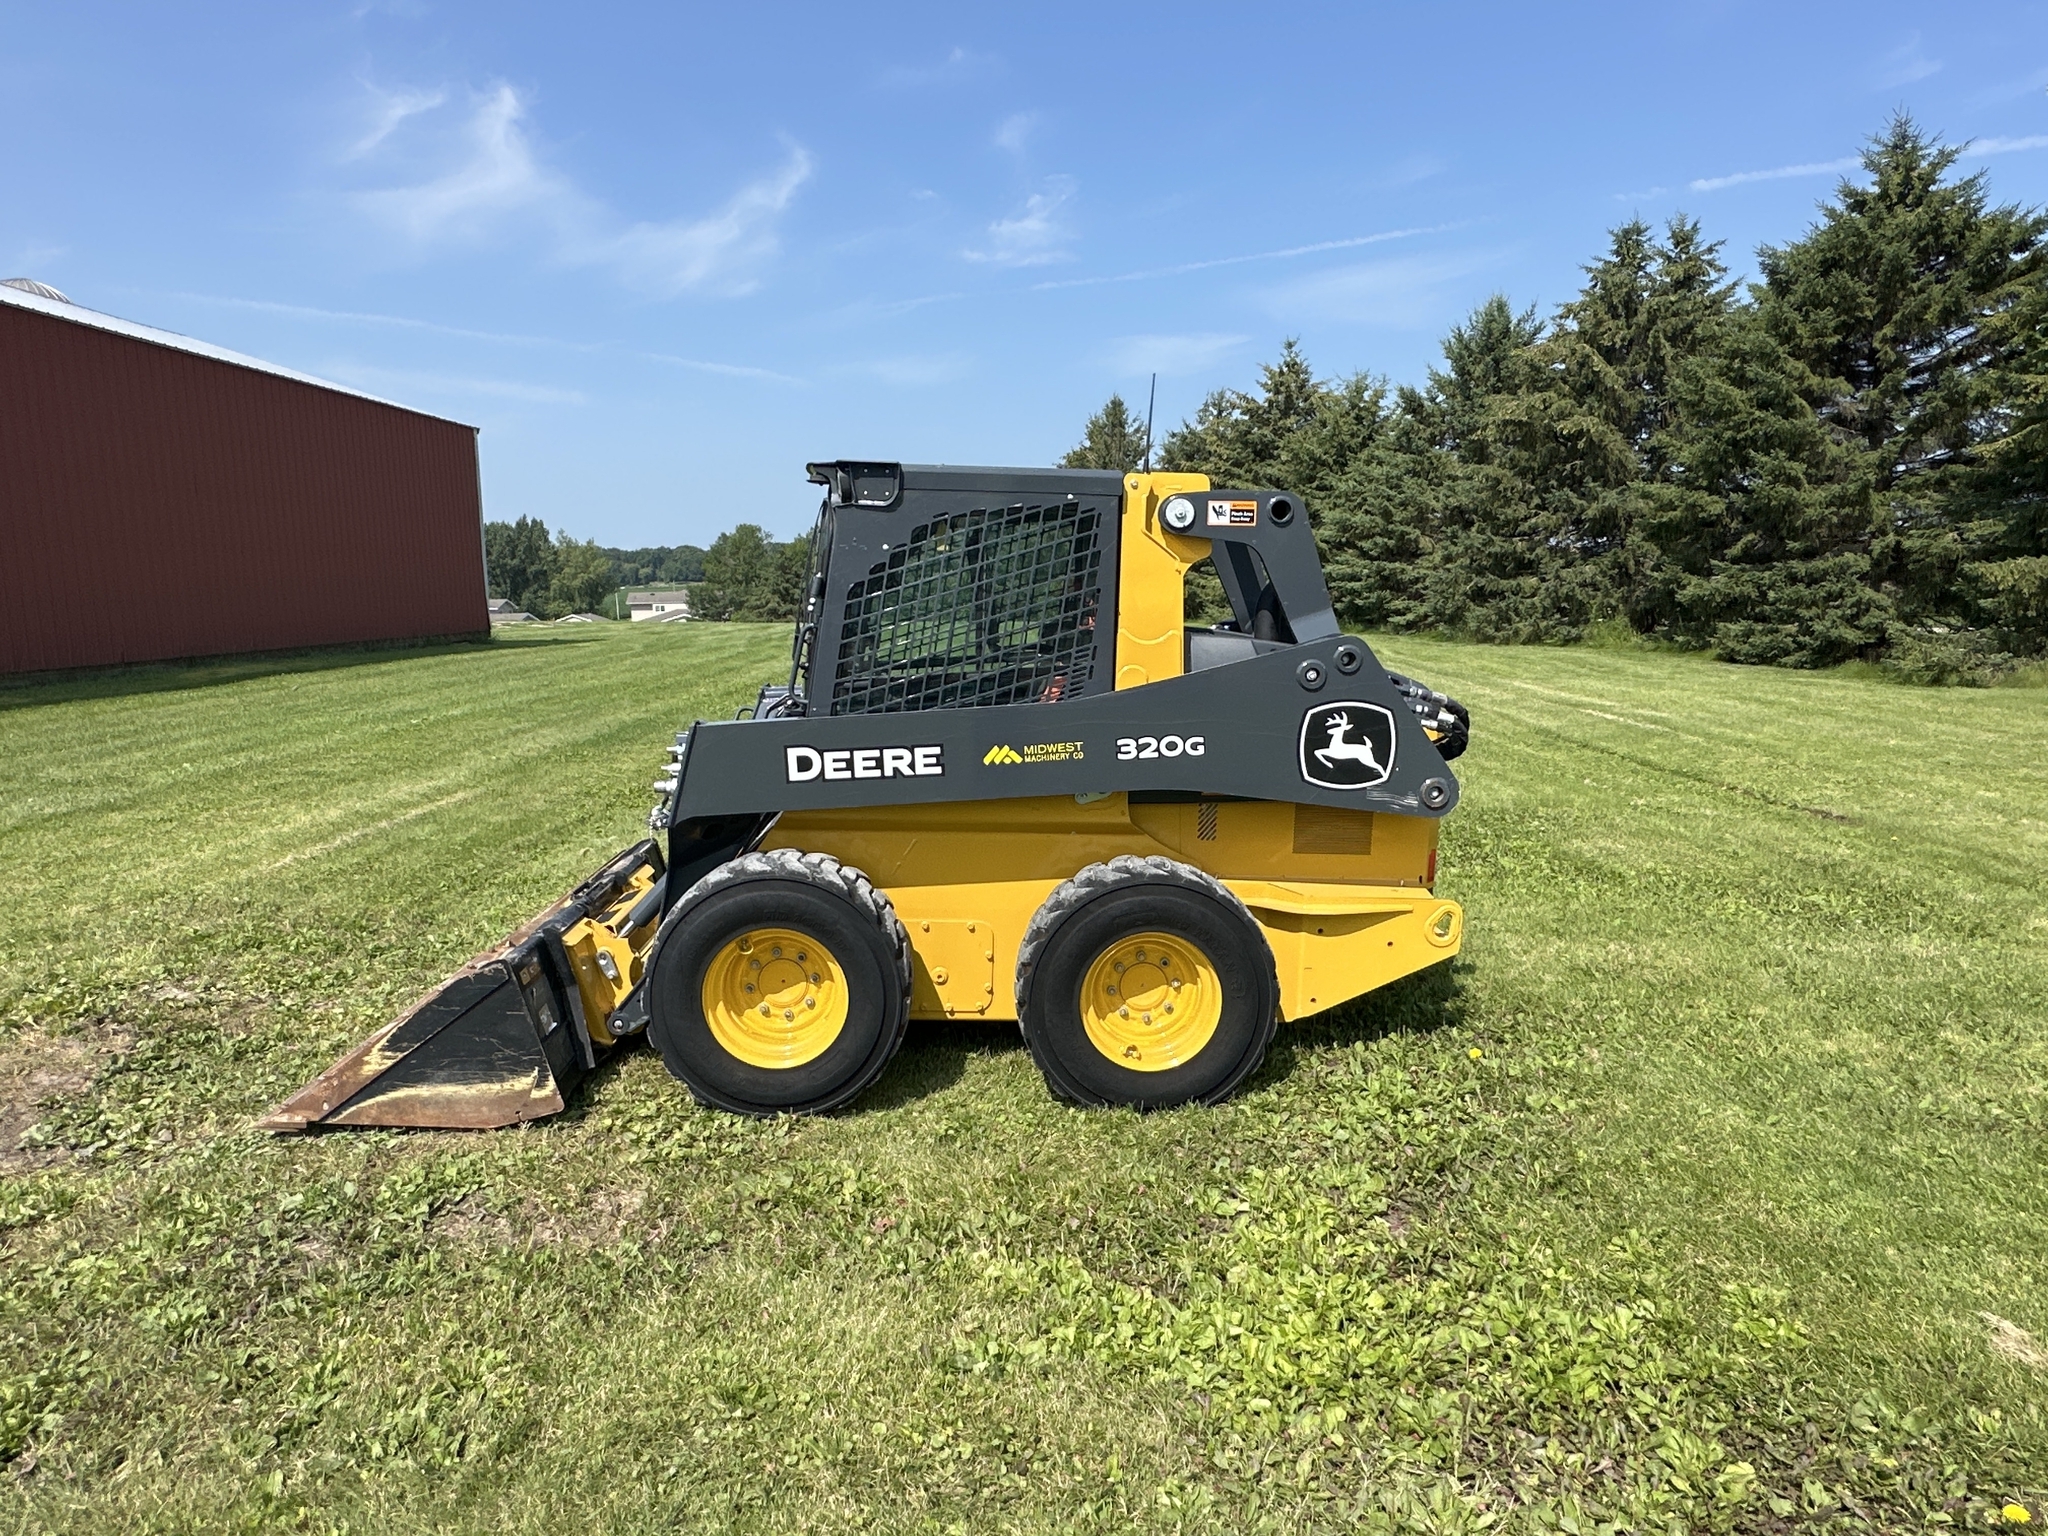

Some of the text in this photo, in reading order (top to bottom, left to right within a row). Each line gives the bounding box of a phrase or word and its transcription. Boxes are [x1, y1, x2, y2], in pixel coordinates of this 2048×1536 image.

[1023, 741, 1084, 755] MIDWEST
[1024, 751, 1084, 763] MACHINERY CO
[1116, 735, 1205, 760] 320G
[786, 746, 943, 782] DEERE
